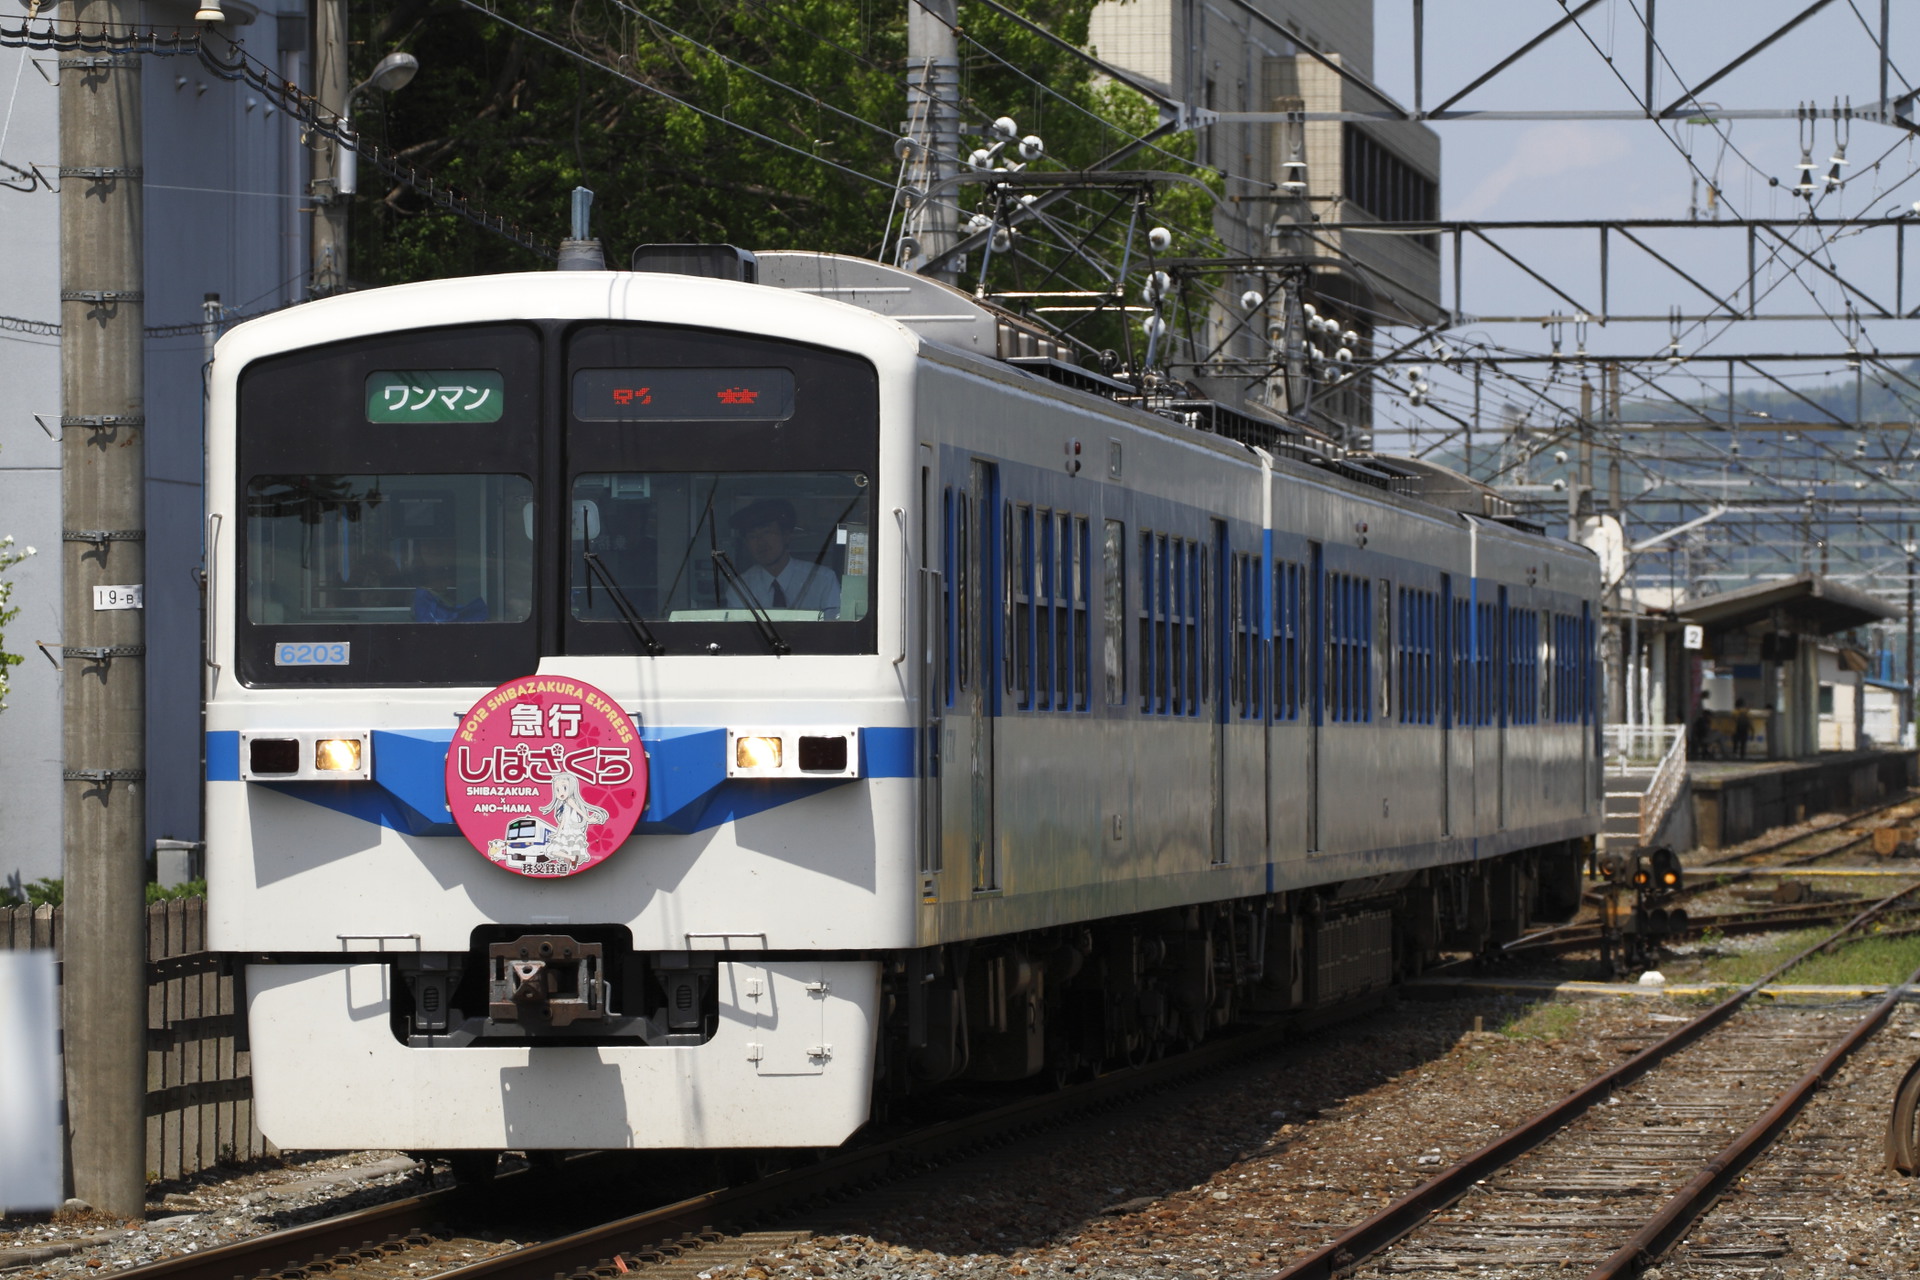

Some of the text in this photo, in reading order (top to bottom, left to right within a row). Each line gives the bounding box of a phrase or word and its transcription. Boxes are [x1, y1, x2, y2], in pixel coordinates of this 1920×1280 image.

[384, 385, 490, 410] ワンマン
[1688, 630, 1699, 645] 2
[280, 644, 346, 664] 6203
[461, 681, 634, 744] 2012 SHIBAZAKURA EXPRESS
[510, 703, 584, 738] 急行
[458, 743, 634, 785] しばざくら
[466, 786, 540, 796] SHIBAZAKURA
[473, 804, 532, 813] ANO-HANA
[522, 863, 569, 875] 秩父鉄道
